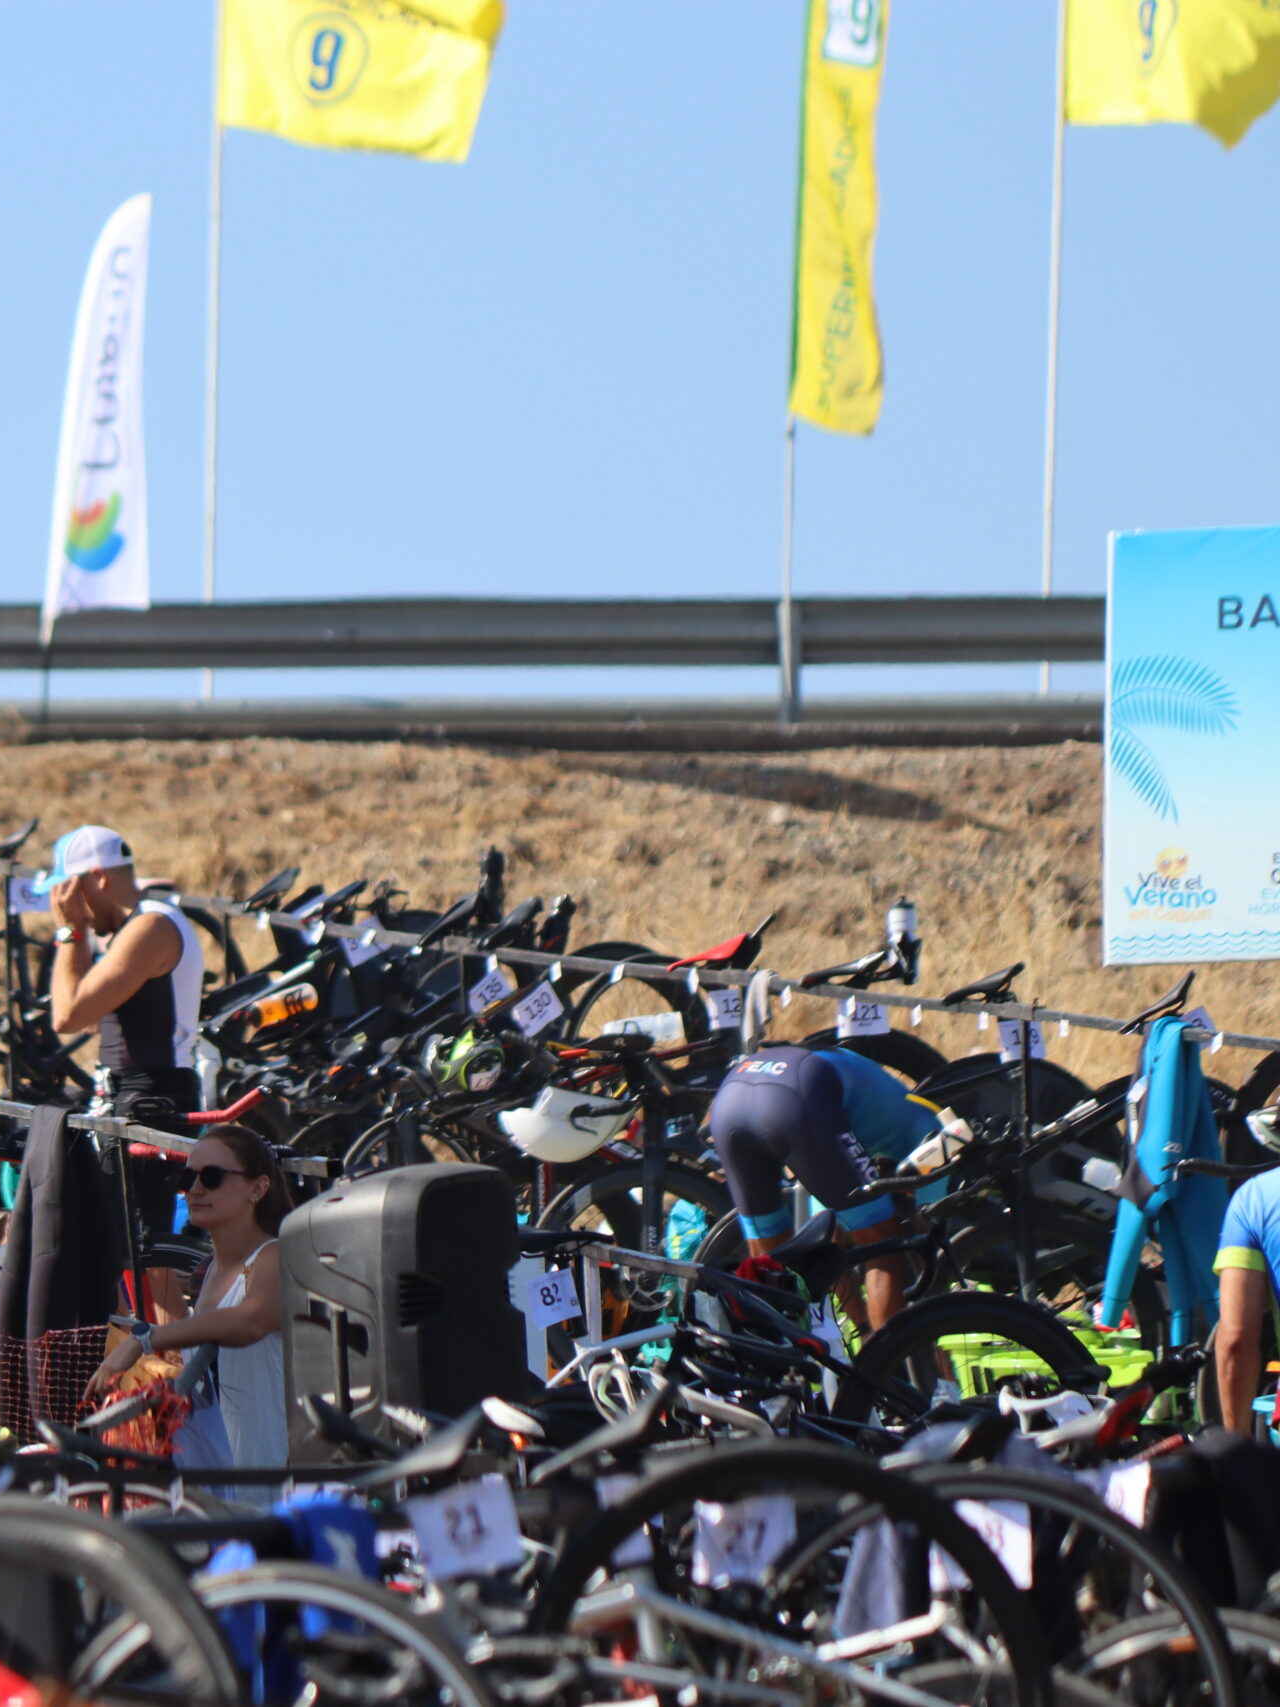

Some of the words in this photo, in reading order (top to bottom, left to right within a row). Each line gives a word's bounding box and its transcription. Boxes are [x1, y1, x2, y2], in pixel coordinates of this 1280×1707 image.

[1138, 871, 1181, 890] Vive
[1185, 872, 1203, 890] el
[1123, 886, 1217, 908] Verano
[524, 990, 553, 1019] 130
[736, 1060, 788, 1076] PEAC
[839, 1130, 880, 1182] PEAC
